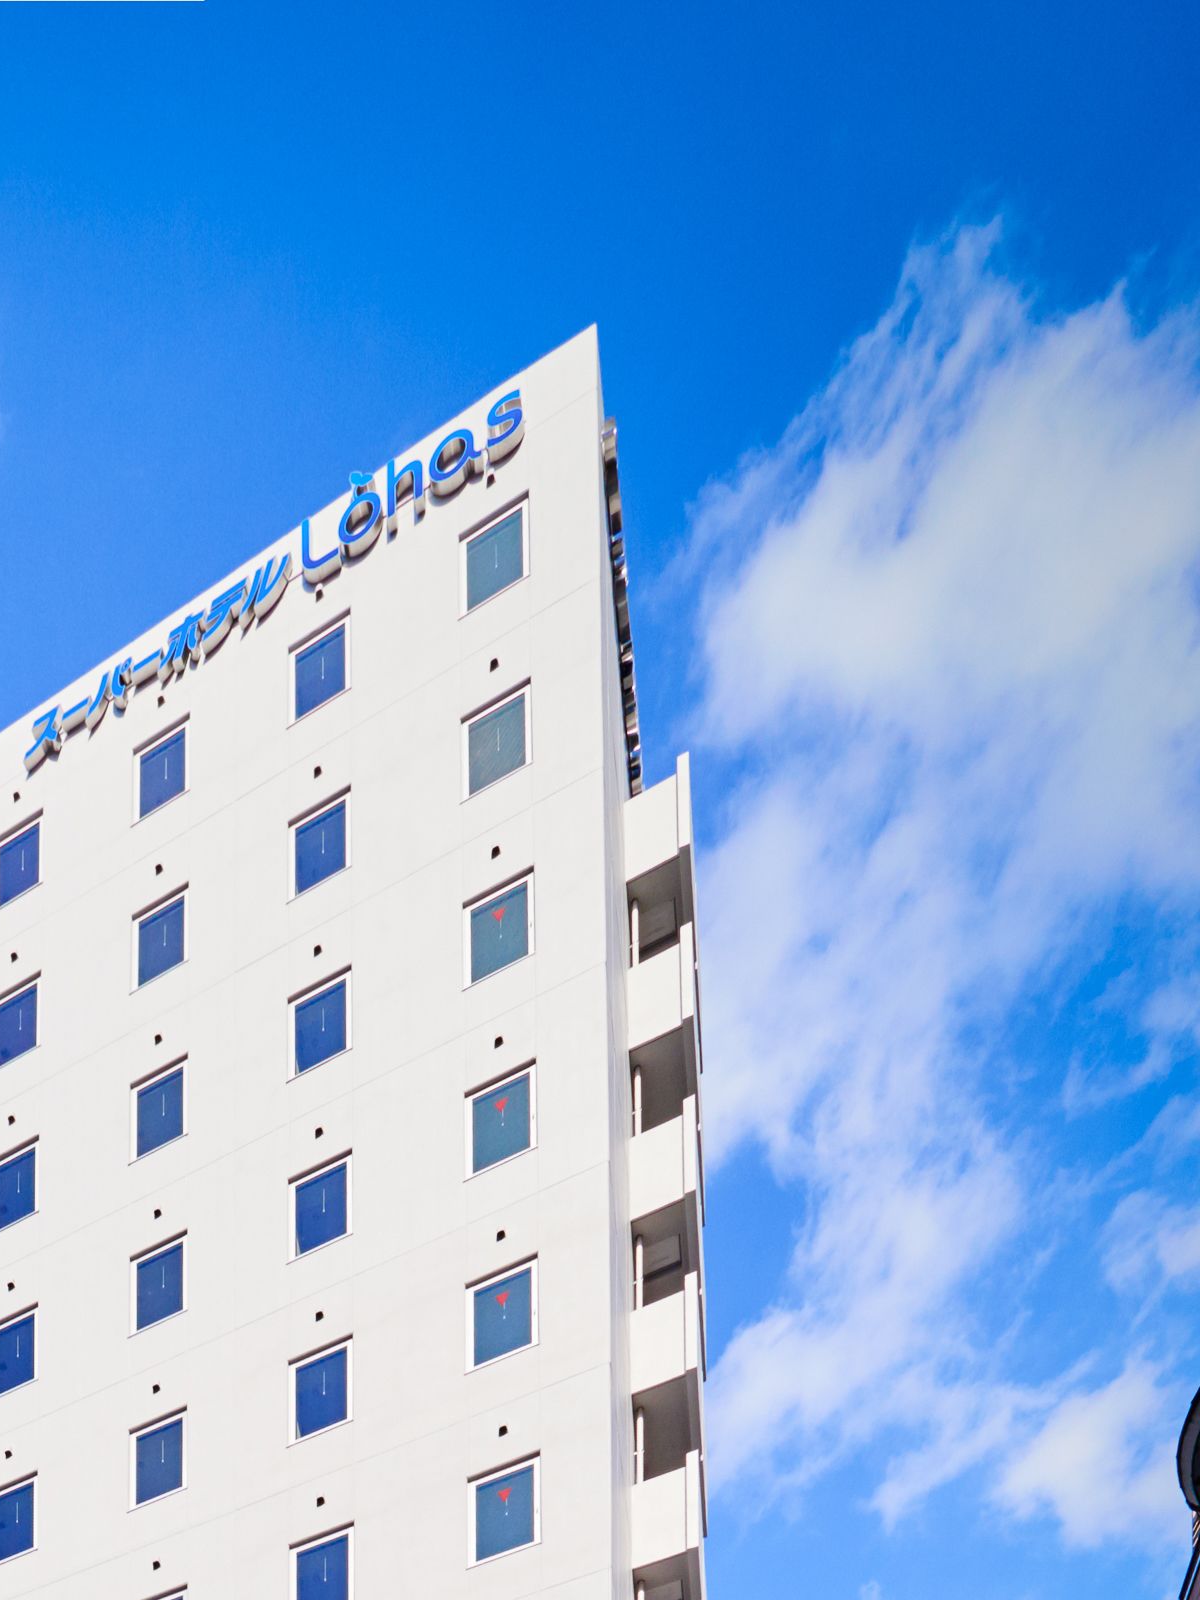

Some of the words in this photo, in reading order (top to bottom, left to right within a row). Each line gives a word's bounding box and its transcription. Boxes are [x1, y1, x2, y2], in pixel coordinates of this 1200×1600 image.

[24, 553, 292, 774] スーパーホテル
